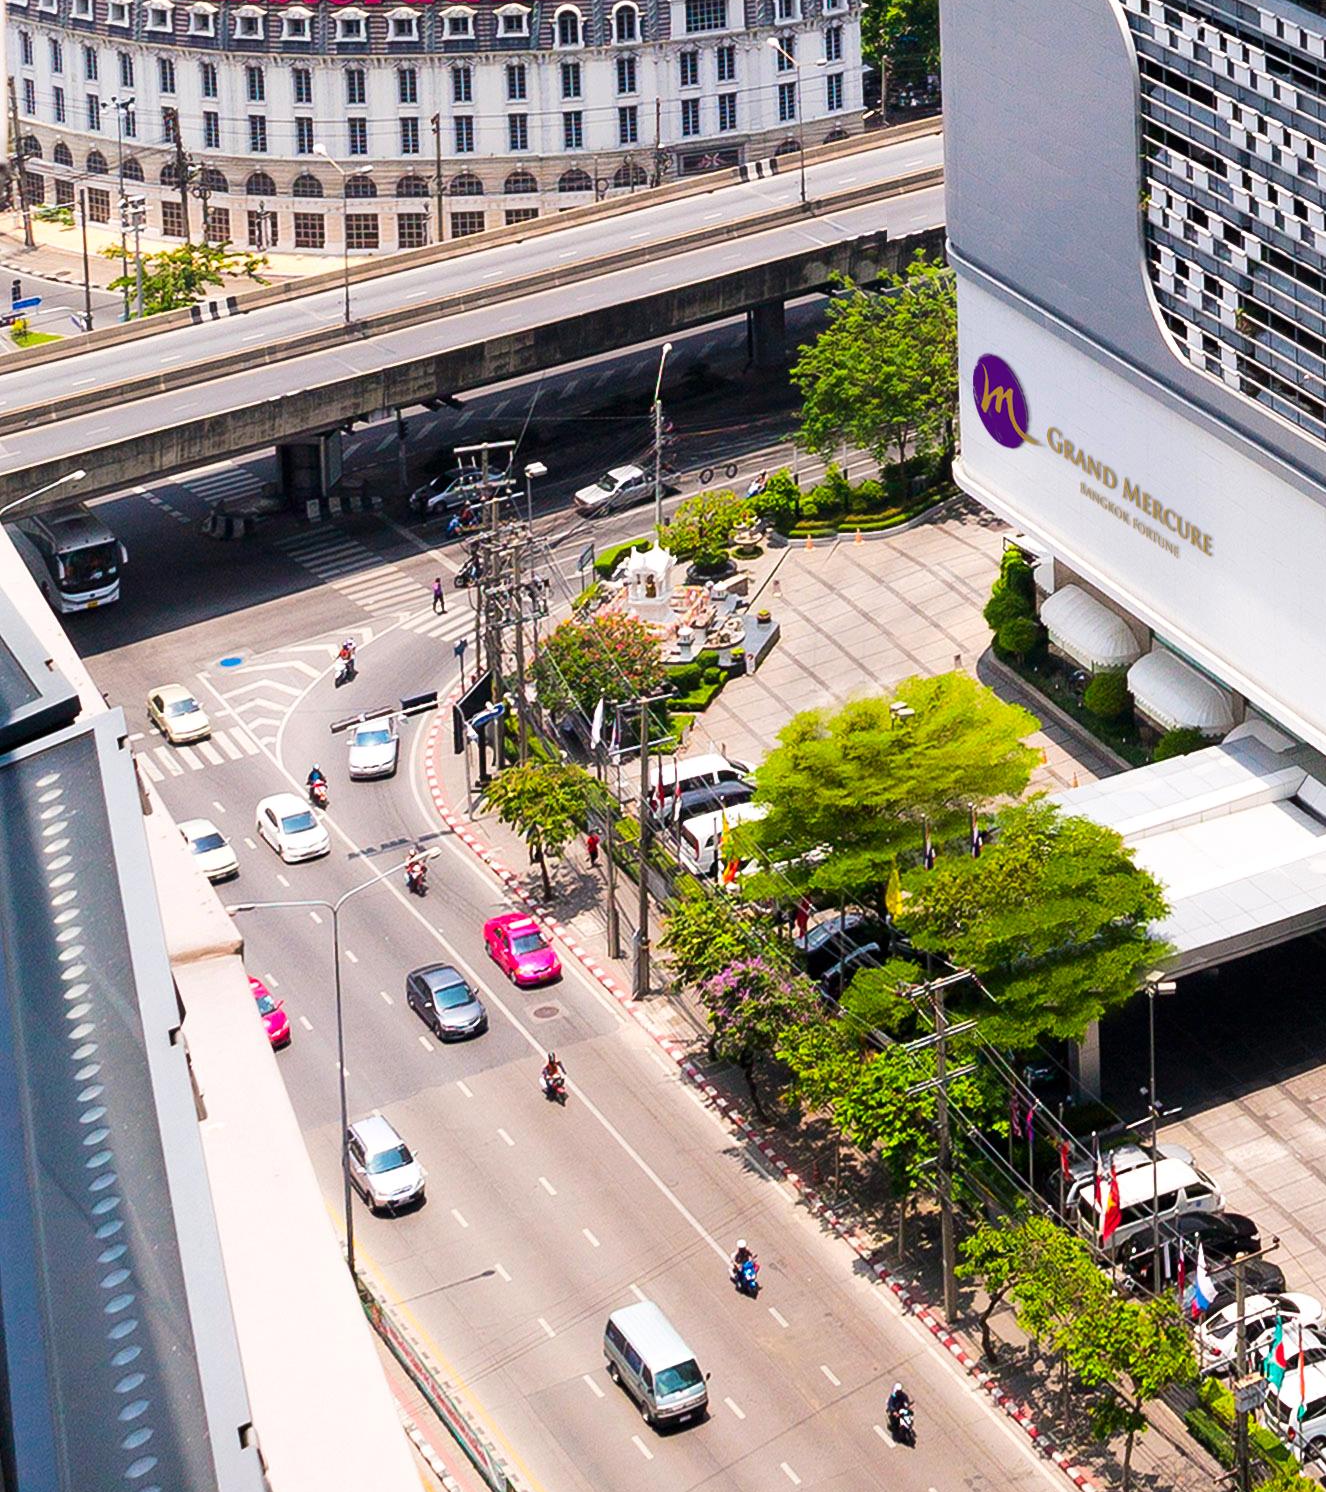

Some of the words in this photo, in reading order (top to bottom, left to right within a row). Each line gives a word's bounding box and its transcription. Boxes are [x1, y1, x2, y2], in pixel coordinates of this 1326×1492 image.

[1047, 426, 1118, 489] GRAND
[1122, 477, 1214, 557] MERCURE
[1079, 481, 1130, 524] BANGKOK
[1132, 517, 1181, 559] FORTUNE
